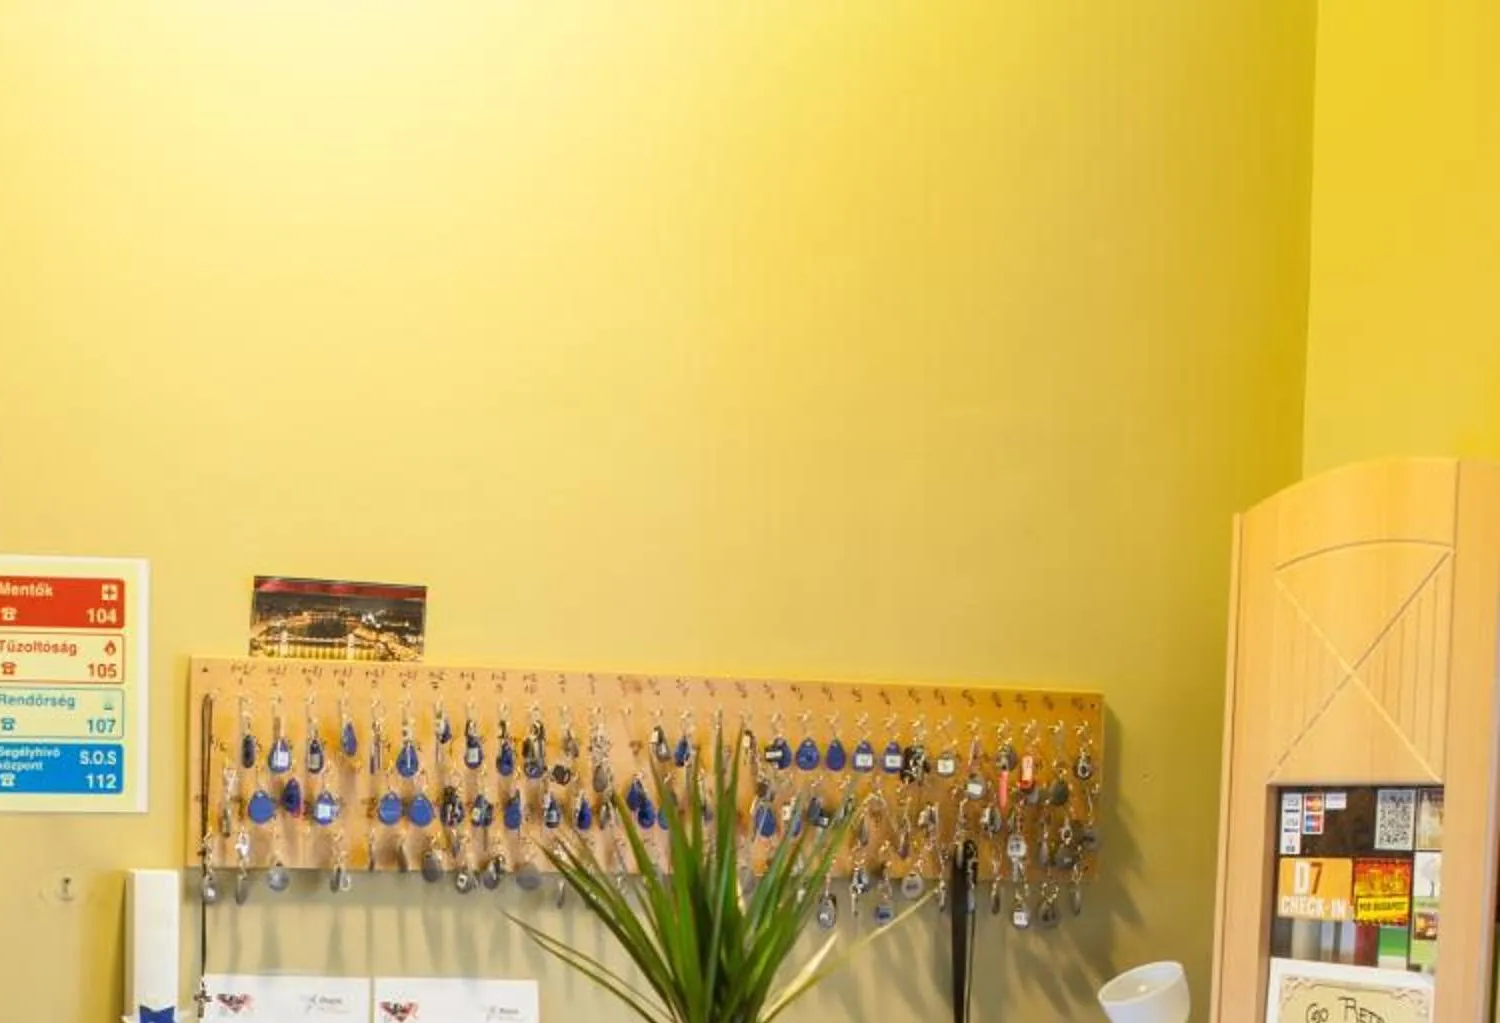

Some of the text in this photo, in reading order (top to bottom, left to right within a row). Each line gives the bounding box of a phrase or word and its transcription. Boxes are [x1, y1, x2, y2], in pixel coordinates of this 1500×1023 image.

[86, 608, 117, 623] 104
[88, 663, 117, 679] 105
[87, 718, 116, 734] 107
[85, 773, 117, 789] 112
